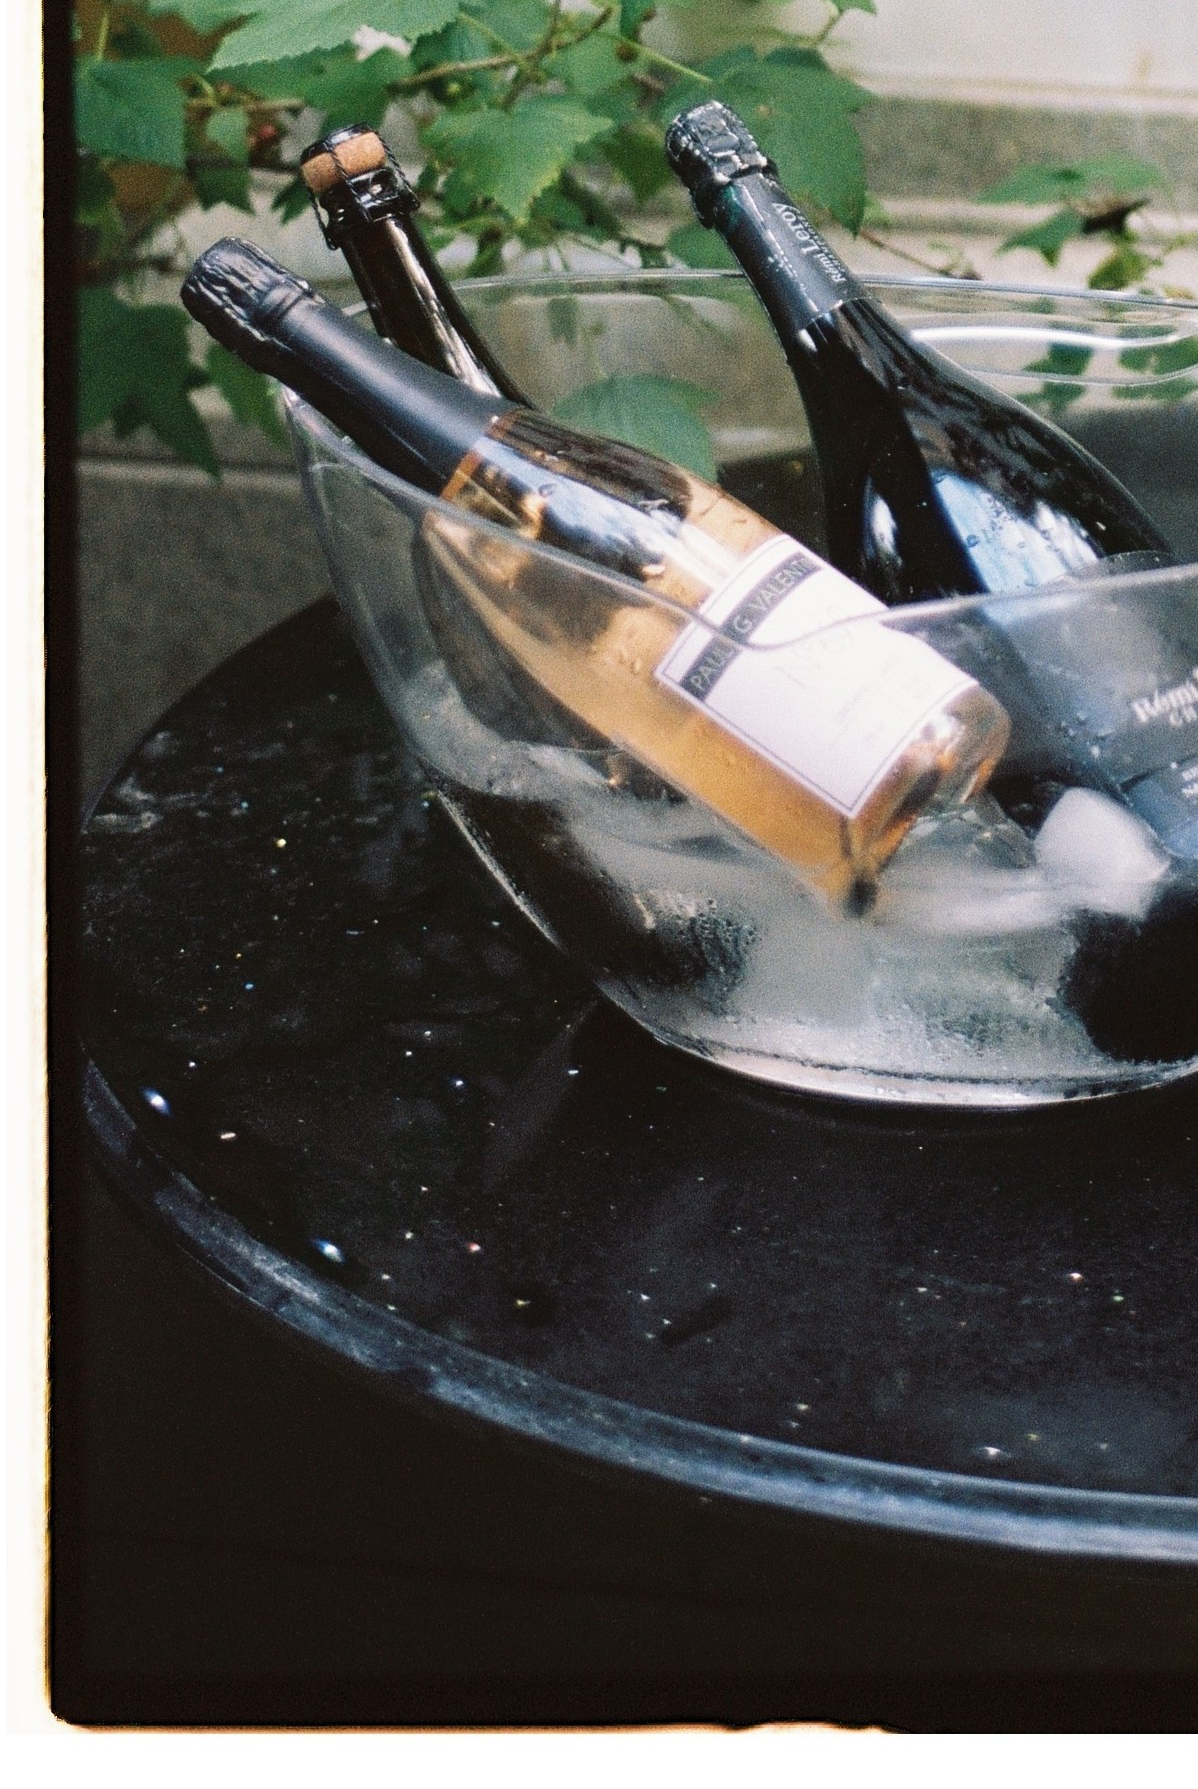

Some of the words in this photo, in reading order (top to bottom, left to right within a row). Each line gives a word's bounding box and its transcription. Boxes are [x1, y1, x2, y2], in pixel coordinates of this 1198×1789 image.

[772, 202, 820, 253] Leroy
[813, 252, 847, 283] Rémi
[691, 645, 735, 689] PAUL
